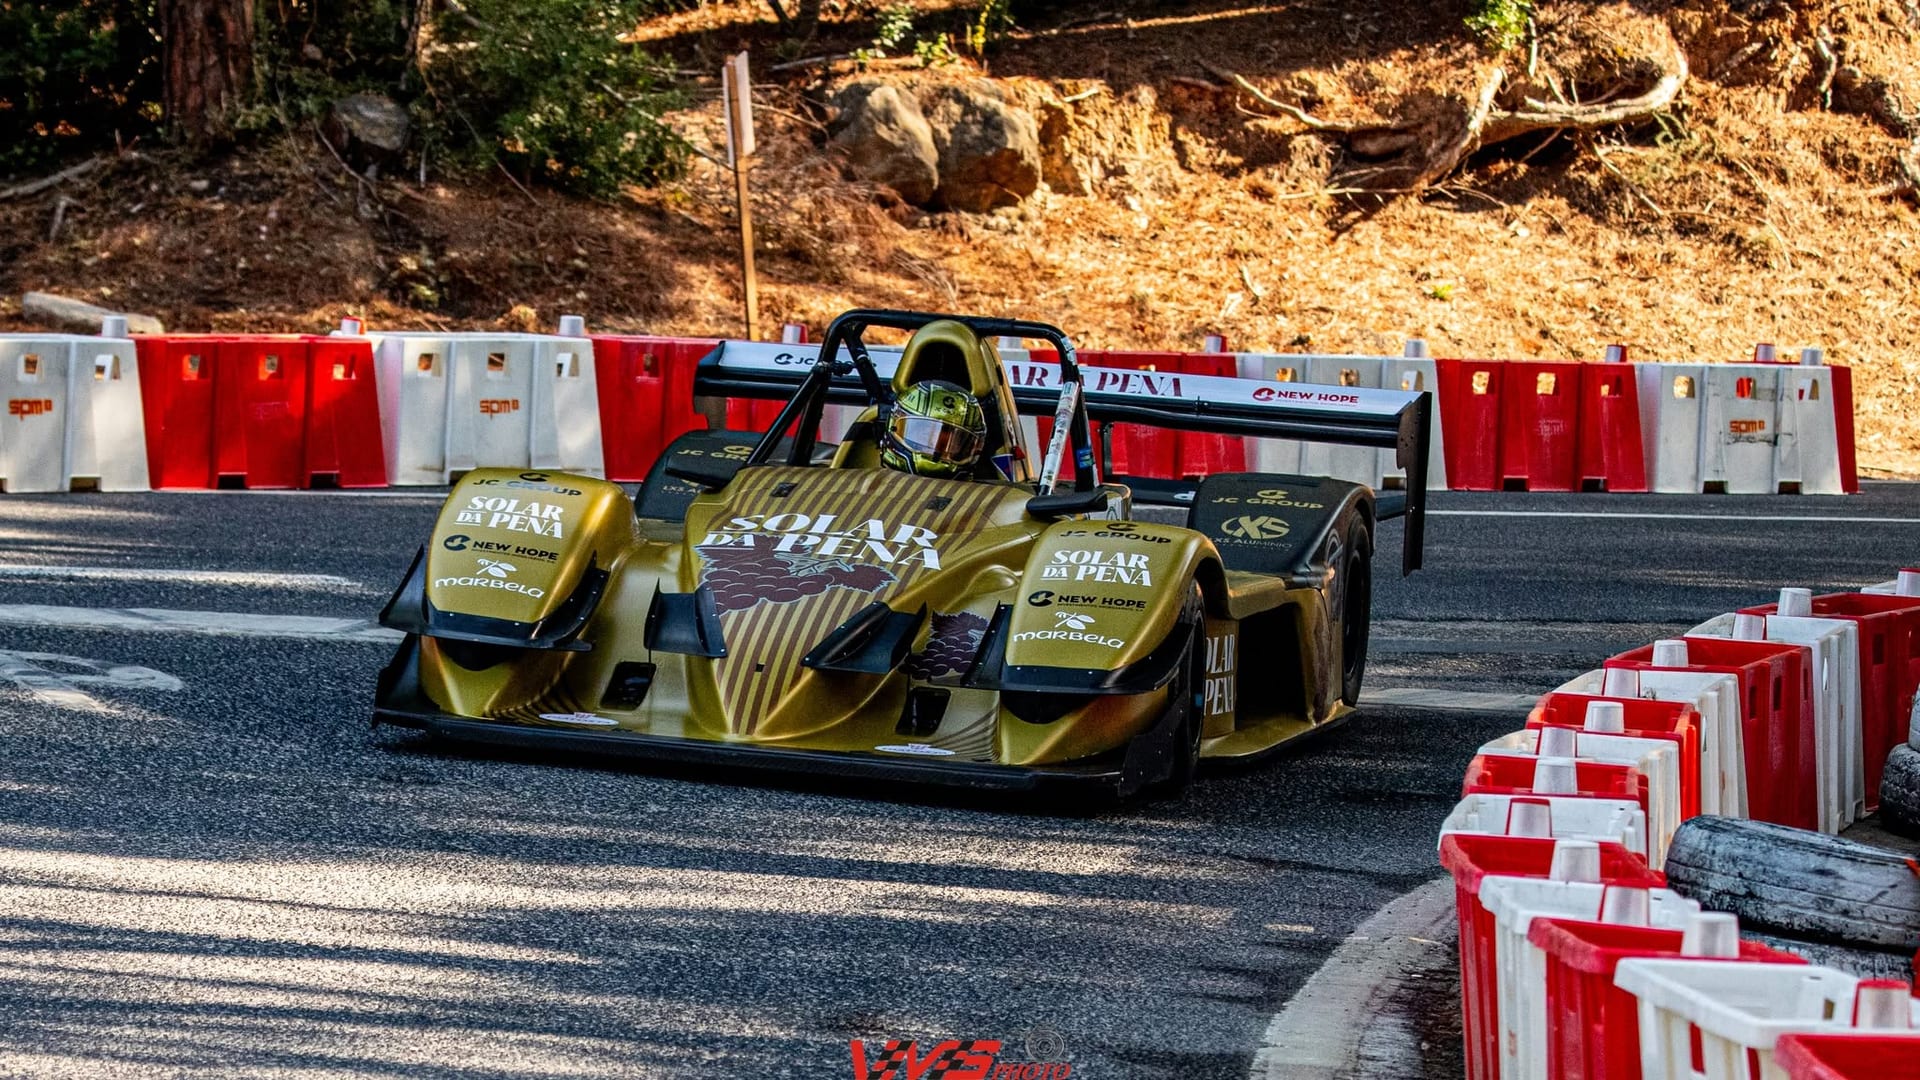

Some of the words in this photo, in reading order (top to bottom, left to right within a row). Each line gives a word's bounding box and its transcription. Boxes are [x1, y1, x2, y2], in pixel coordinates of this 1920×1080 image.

[795, 357, 815, 366] JC
[1003, 364, 1049, 387] AR
[1095, 371, 1183, 397] PENA
[1278, 390, 1313, 400] NEW
[1318, 393, 1359, 404] HOPE
[506, 480, 583, 496] GROUP
[467, 495, 565, 522] SOLAR
[1246, 498, 1324, 509] GROUP
[455, 511, 484, 526] DA
[488, 512, 564, 540] PENA
[722, 513, 939, 548] SOLAR
[1060, 530, 1087, 538] JC
[1094, 530, 1172, 544] GROUP
[473, 541, 512, 552] NEW
[515, 546, 560, 561] HOPE
[700, 532, 756, 548] DA
[772, 532, 942, 571] PENA
[1051, 549, 1150, 570] SOLAR
[1041, 566, 1069, 580] DA
[1075, 565, 1153, 587] PENA
[1058, 594, 1097, 604] NEW
[1101, 597, 1147, 609] HOPE
